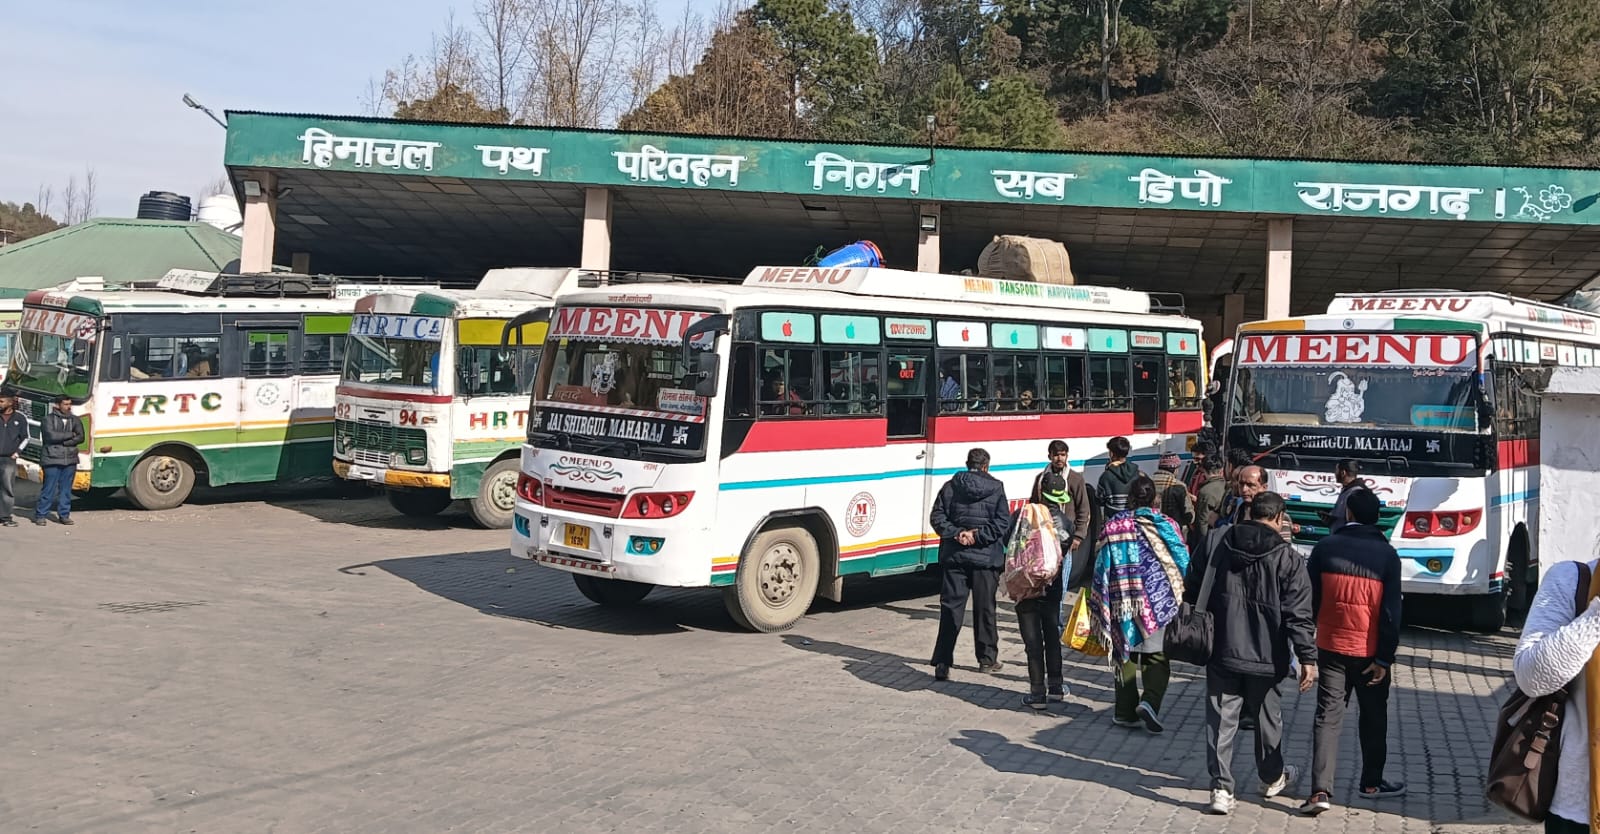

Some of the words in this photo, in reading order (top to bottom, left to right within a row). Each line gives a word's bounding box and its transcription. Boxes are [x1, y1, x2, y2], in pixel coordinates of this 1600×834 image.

[297, 127, 441, 170] हिमाचल
[475, 144, 551, 175] पथ
[611, 145, 748, 186] परिवहन
[990, 170, 1078, 200] सब
[1127, 168, 1233, 207] डिपो
[1293, 181, 1484, 220] राजगढ़
[759, 268, 851, 285] MEENU
[964, 278, 993, 293] MEENU
[1350, 298, 1473, 312] MEENU
[22, 307, 80, 337] HRTC
[357, 314, 431, 339] HRTC
[552, 308, 712, 342] MEENU
[1241, 335, 1475, 365] MEENU
[899, 370, 915, 379] OUT
[108, 391, 222, 416] HRTC
[337, 402, 351, 419] 62
[400, 409, 417, 426] 94
[547, 412, 564, 433] JAI
[564, 414, 606, 437] SHIRGUL
[609, 418, 666, 443] MAHARAJ
[1282, 434, 1300, 448] JAI
[1302, 434, 1352, 449] SHIRGUL
[568, 456, 602, 468] MEENU
[855, 503, 867, 516] M
